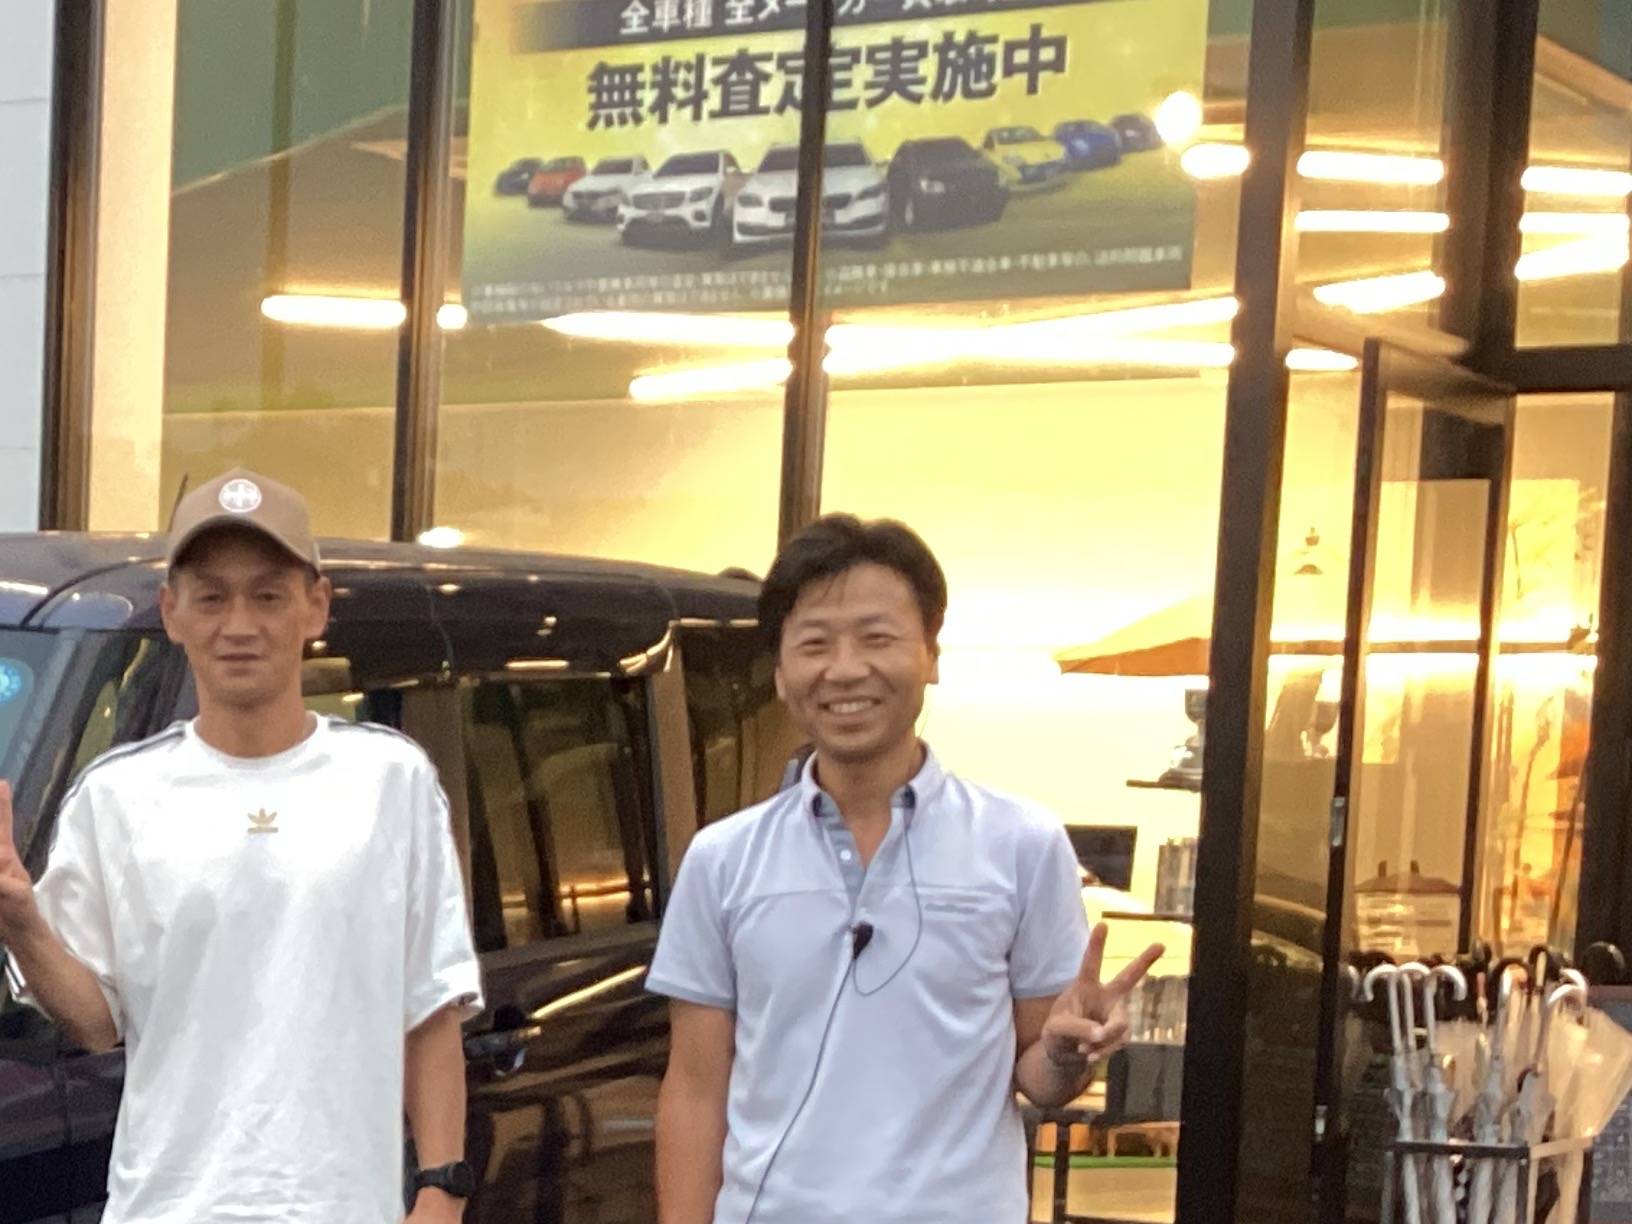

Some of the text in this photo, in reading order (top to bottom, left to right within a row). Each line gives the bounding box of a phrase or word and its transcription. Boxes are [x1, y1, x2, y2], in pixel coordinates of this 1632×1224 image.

[585, 23, 1069, 131] 無料査定実施中
